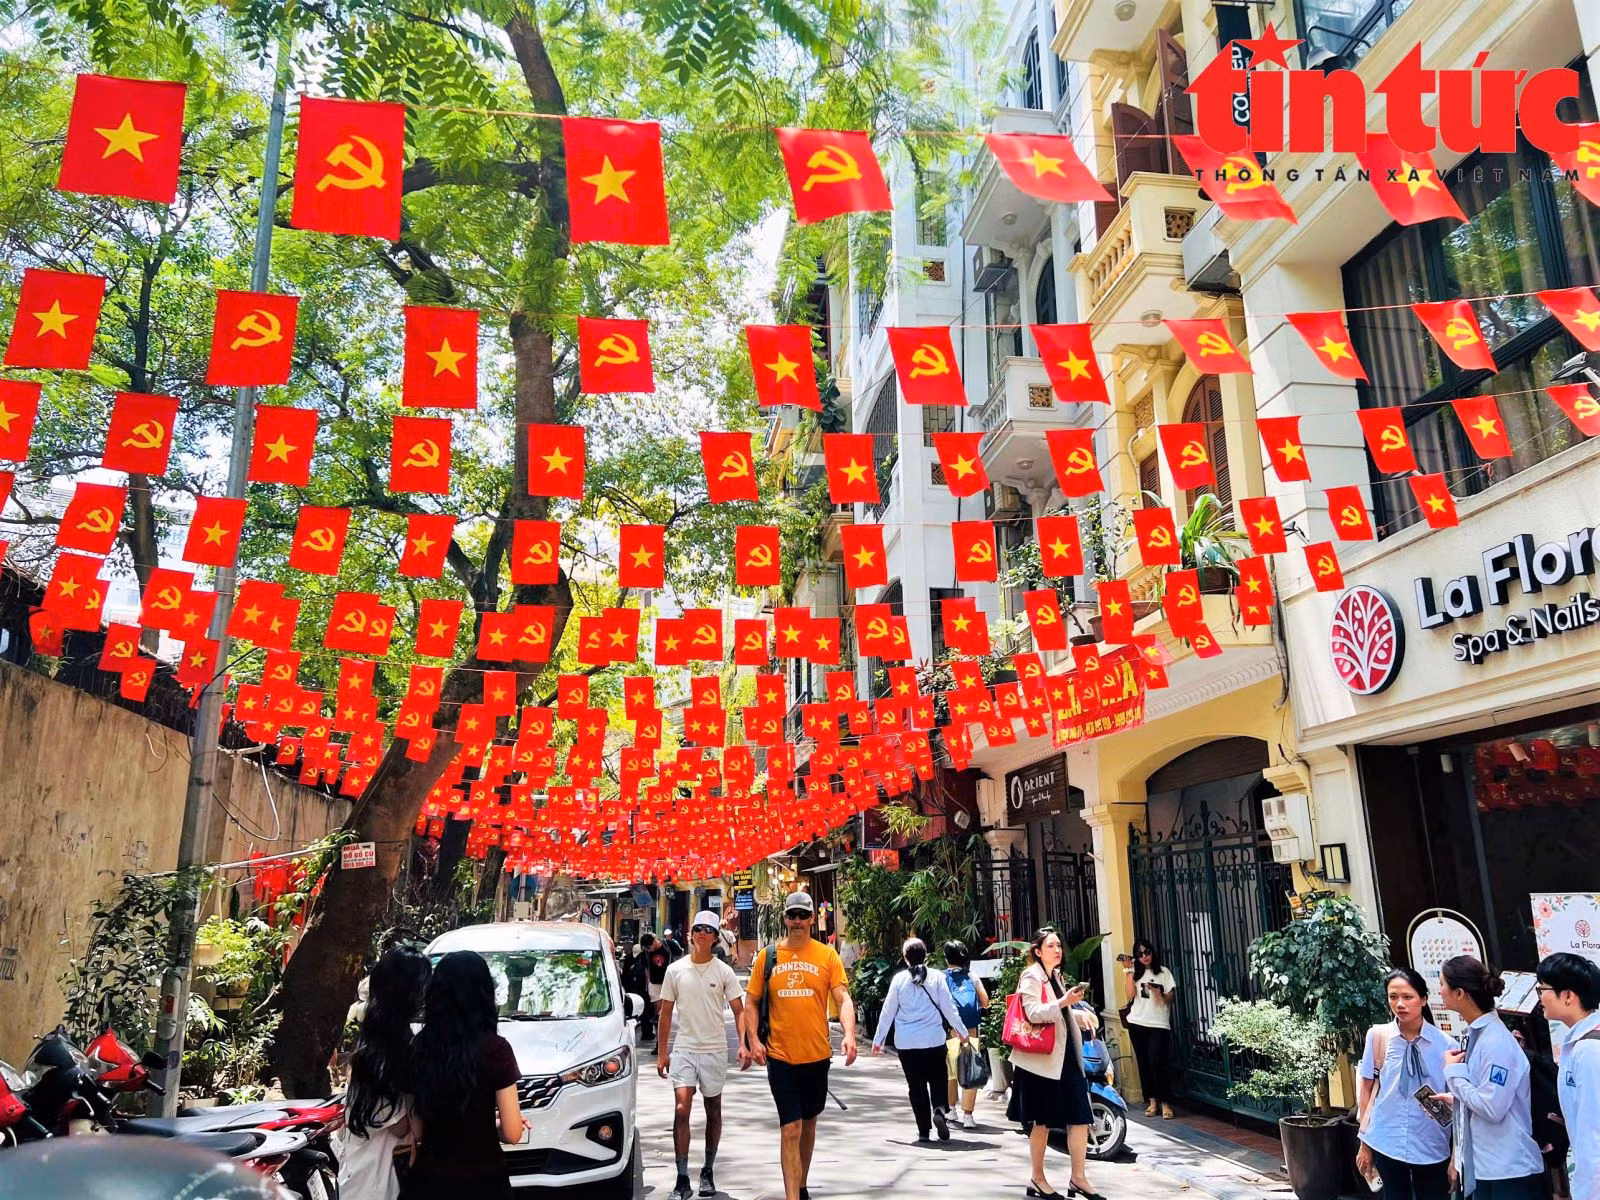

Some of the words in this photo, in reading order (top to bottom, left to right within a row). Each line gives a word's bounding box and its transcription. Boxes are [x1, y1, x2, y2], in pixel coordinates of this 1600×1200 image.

[1414, 575, 1483, 629] La
[1482, 524, 1600, 606] Flor
[1452, 629, 1508, 665] Spa
[1505, 615, 1534, 645] &
[1530, 592, 1600, 639] Nails
[1024, 771, 1055, 792] ORIENT
[1570, 941, 1580, 949] La
[772, 961, 819, 977] TENNESSEE
